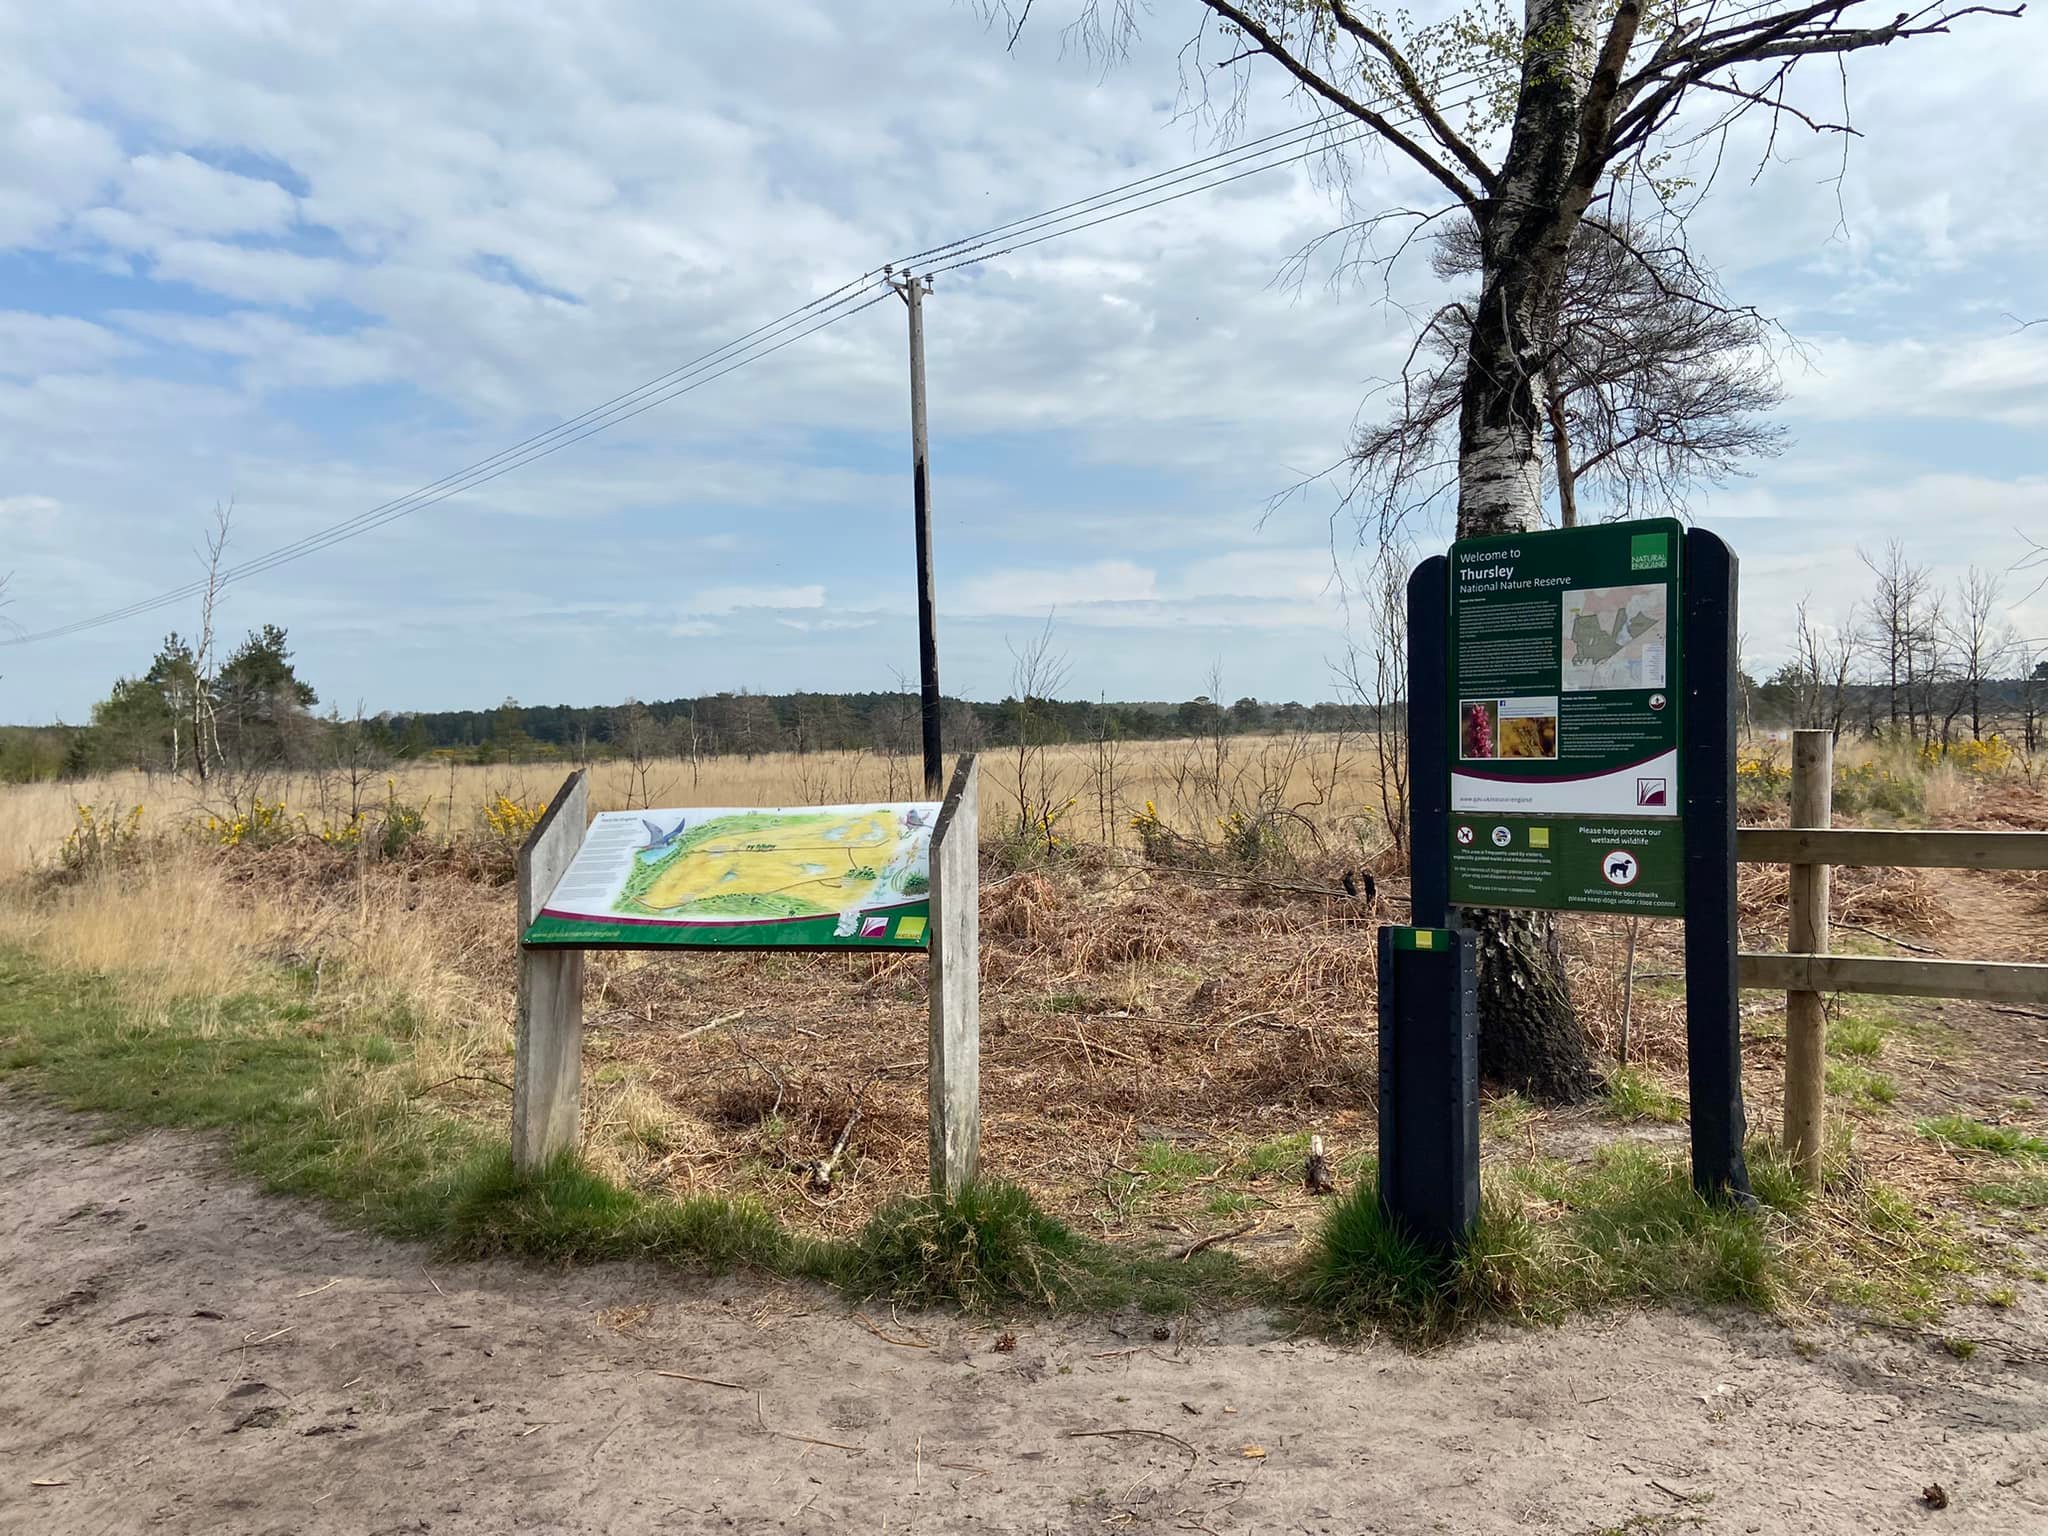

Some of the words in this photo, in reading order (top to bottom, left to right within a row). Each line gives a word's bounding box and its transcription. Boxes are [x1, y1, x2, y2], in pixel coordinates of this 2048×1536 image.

[1460, 549, 1508, 563] Welcome
[1510, 549, 1521, 558] to
[1631, 554, 1666, 562] NATURAL
[1631, 561, 1667, 570] ENGLAND
[1460, 565, 1514, 581] Thursley
[1459, 581, 1498, 594] National
[1500, 579, 1532, 591] Nature
[1534, 576, 1572, 587] Reserve
[1578, 826, 1601, 834] Please
[1602, 827, 1619, 836] help
[1620, 827, 1647, 837] protect
[1590, 837, 1620, 845] wetland
[1621, 837, 1649, 845] wildlife
[1587, 896, 1602, 904] keep
